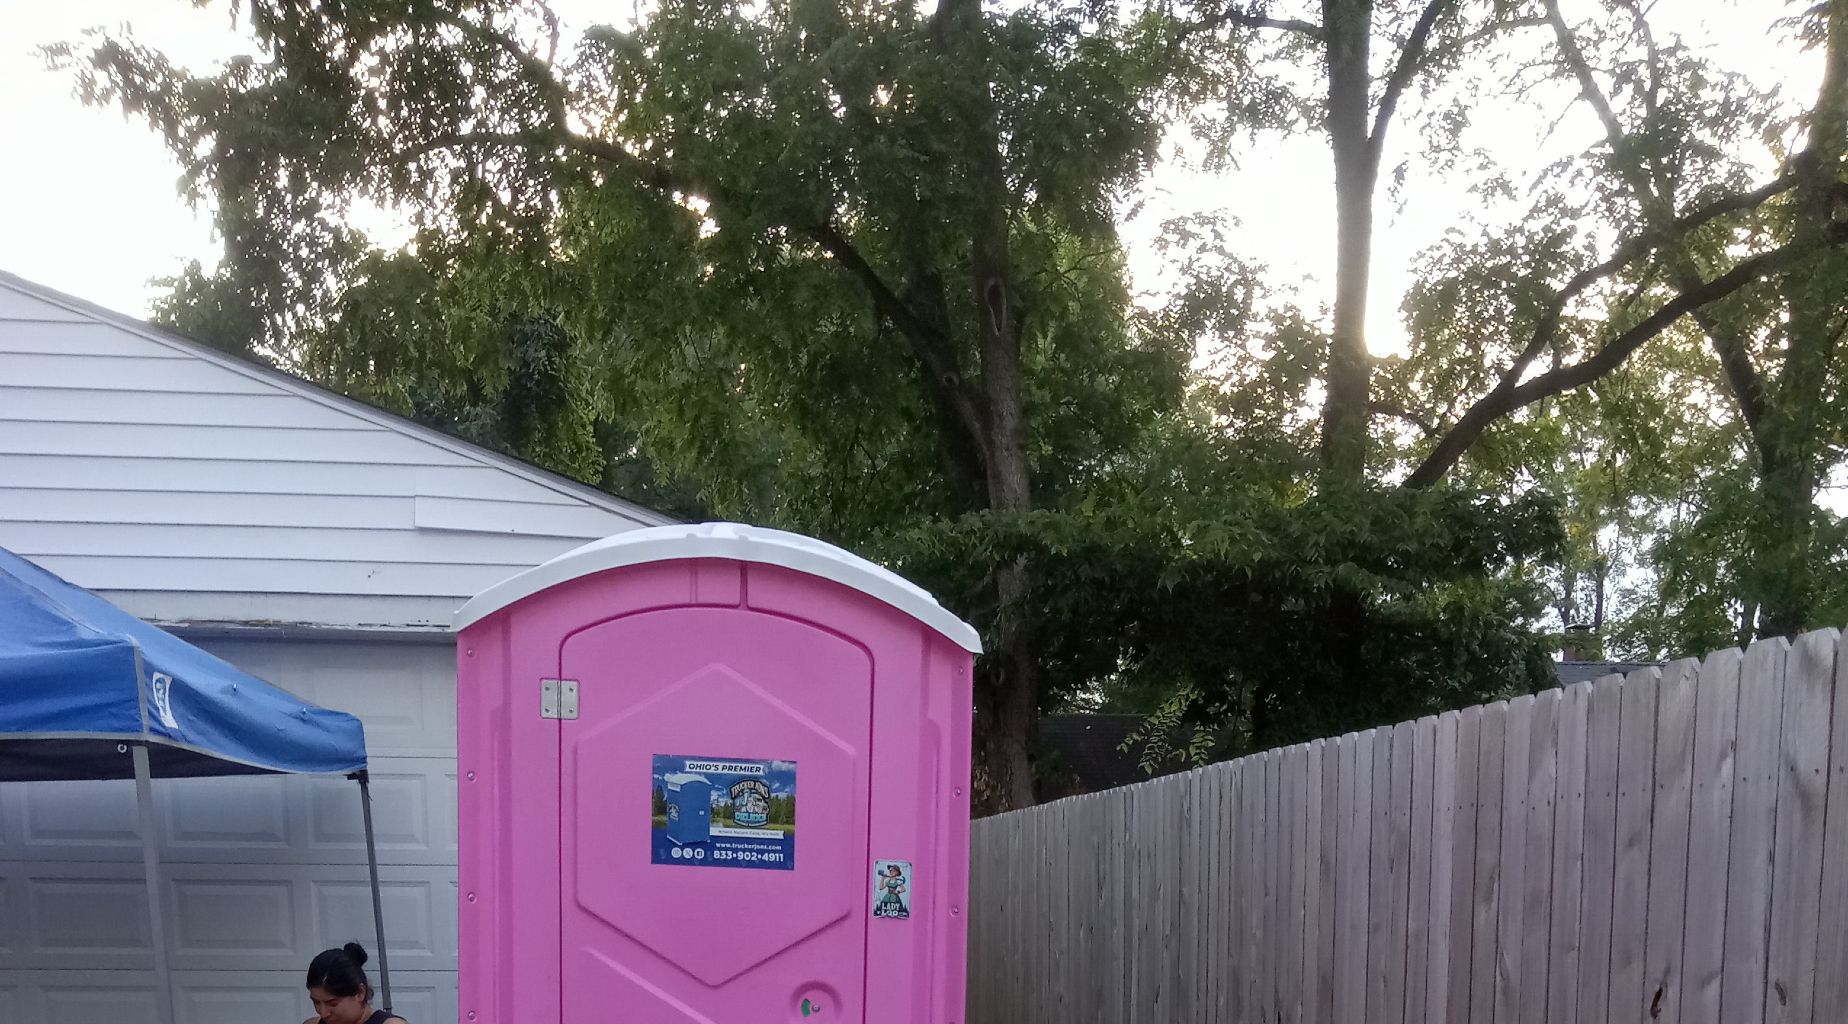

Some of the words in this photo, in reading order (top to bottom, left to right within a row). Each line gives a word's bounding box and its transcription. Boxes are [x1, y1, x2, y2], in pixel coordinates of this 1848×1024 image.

[688, 763, 719, 772] OHIO'S
[721, 764, 762, 773] PREMIER
[715, 842, 782, 850] www.truckerjons.com
